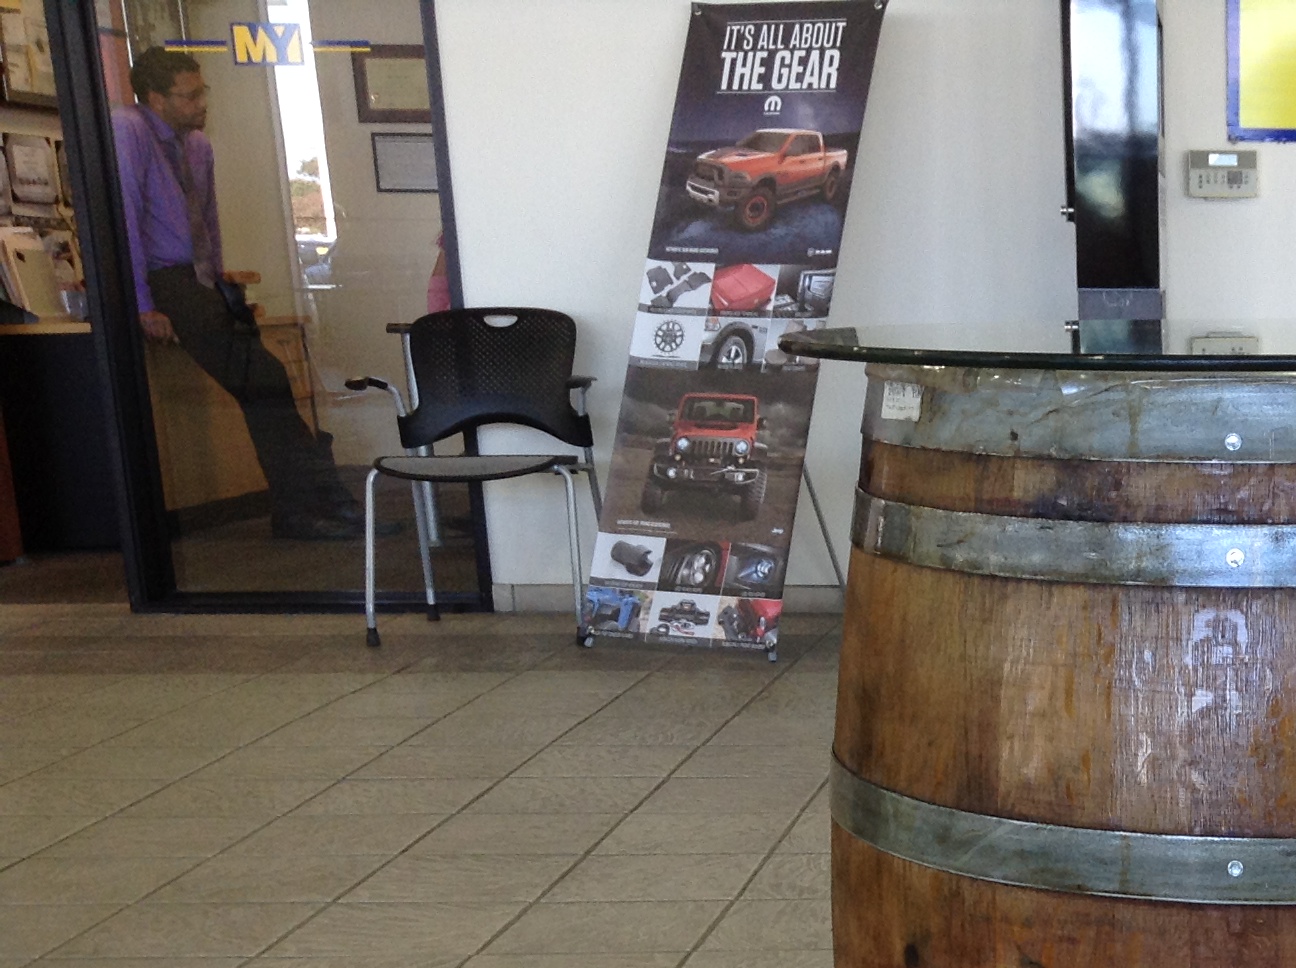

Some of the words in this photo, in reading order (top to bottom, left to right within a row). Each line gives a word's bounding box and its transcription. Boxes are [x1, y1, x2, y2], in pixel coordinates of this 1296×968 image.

[233, 24, 301, 64] MY
[723, 24, 755, 50] IT'S
[757, 24, 784, 49] ALL
[789, 22, 847, 49] ABOUT
[720, 50, 769, 91] THE
[771, 49, 840, 90] GEAR
